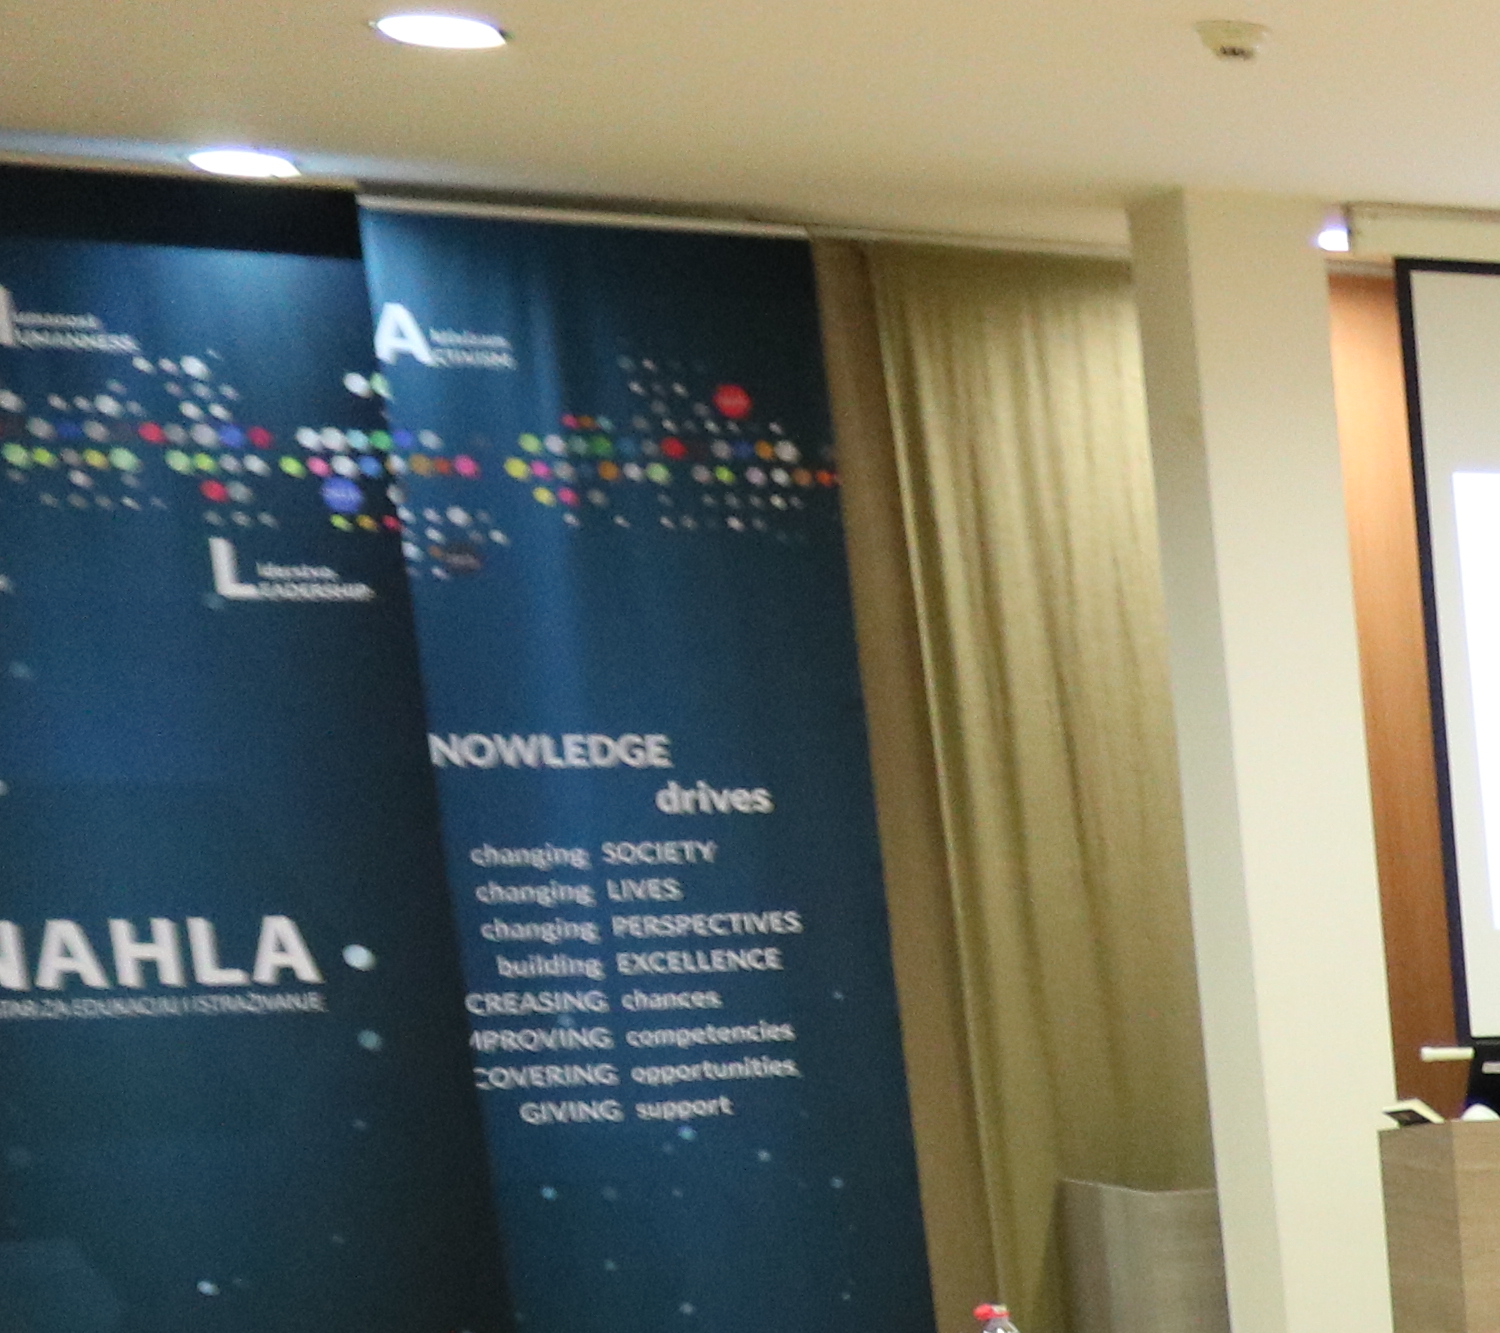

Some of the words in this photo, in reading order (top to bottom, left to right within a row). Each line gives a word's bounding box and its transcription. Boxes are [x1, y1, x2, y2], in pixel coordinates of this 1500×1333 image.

[655, 780, 775, 815] drives
[469, 843, 592, 871] changing
[601, 840, 718, 865] SOCIETY
[475, 880, 597, 907] changing
[606, 878, 684, 902] LIVES
[481, 918, 601, 945] changing
[611, 910, 803, 938] PERSPECTIVES
[496, 953, 606, 981] building
[616, 947, 785, 976] EXCELLENCE
[620, 988, 724, 1012] chances
[625, 1019, 796, 1049] competencies
[519, 1099, 625, 1125] GIVING
[635, 1094, 735, 1121] support
